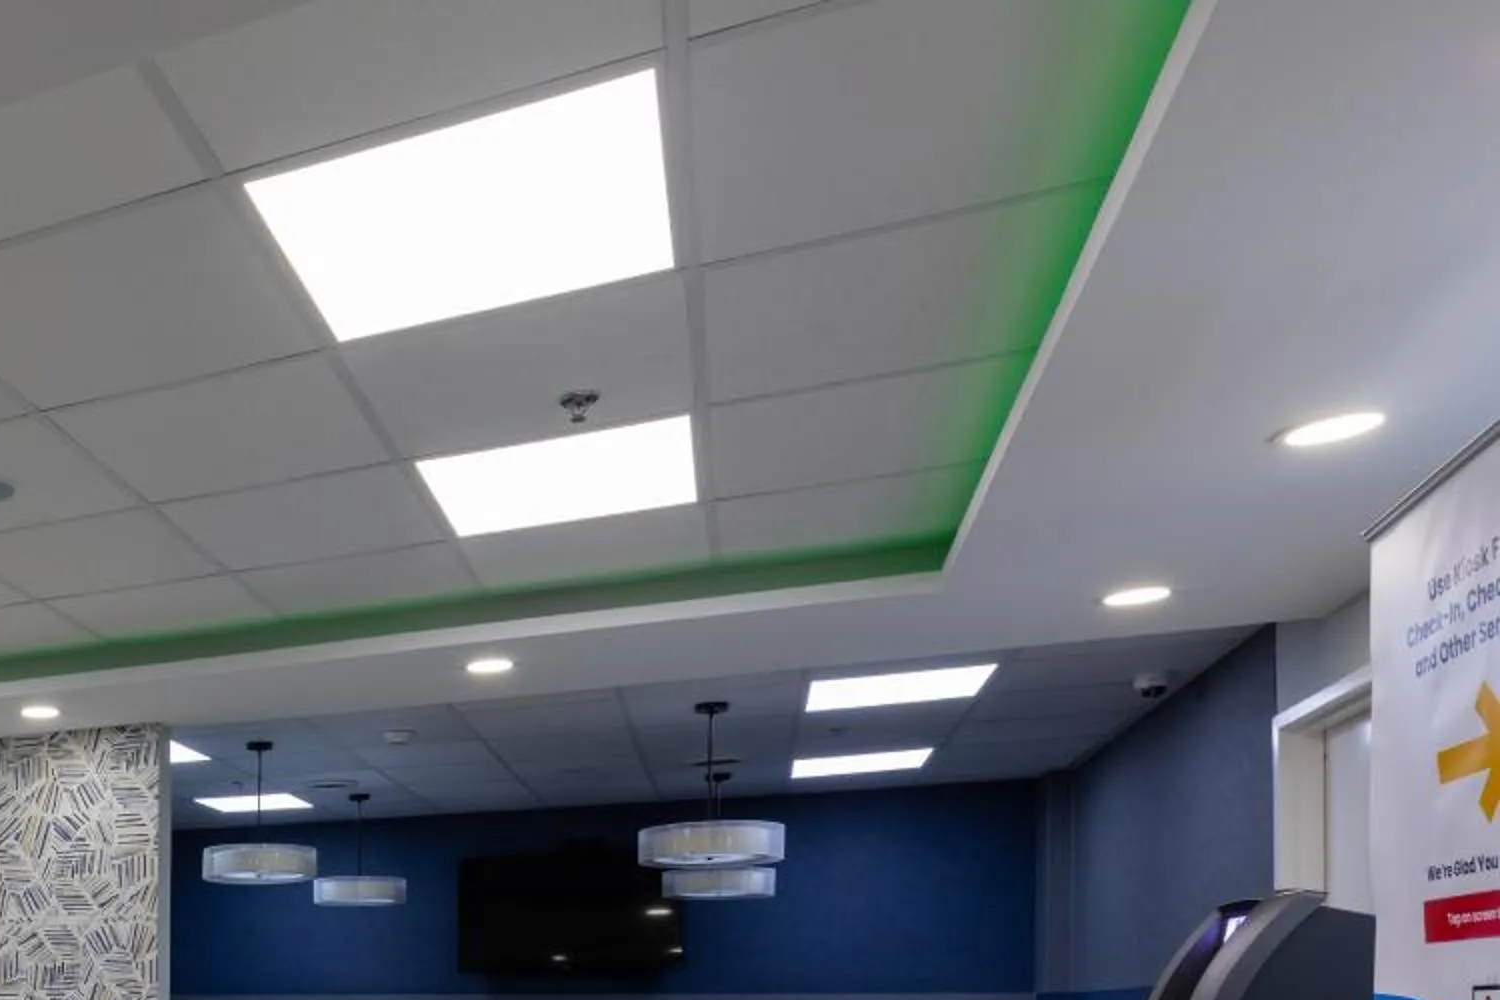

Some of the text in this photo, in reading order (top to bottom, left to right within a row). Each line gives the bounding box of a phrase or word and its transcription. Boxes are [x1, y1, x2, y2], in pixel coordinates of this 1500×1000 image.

[1428, 574, 1451, 601] Use
[1453, 543, 1490, 585] Kiosk
[1406, 602, 1465, 648] Check-In,
[1415, 646, 1437, 678] and
[1439, 630, 1476, 664] Other
[1453, 856, 1477, 877] Glad
[1477, 854, 1499, 872] You
